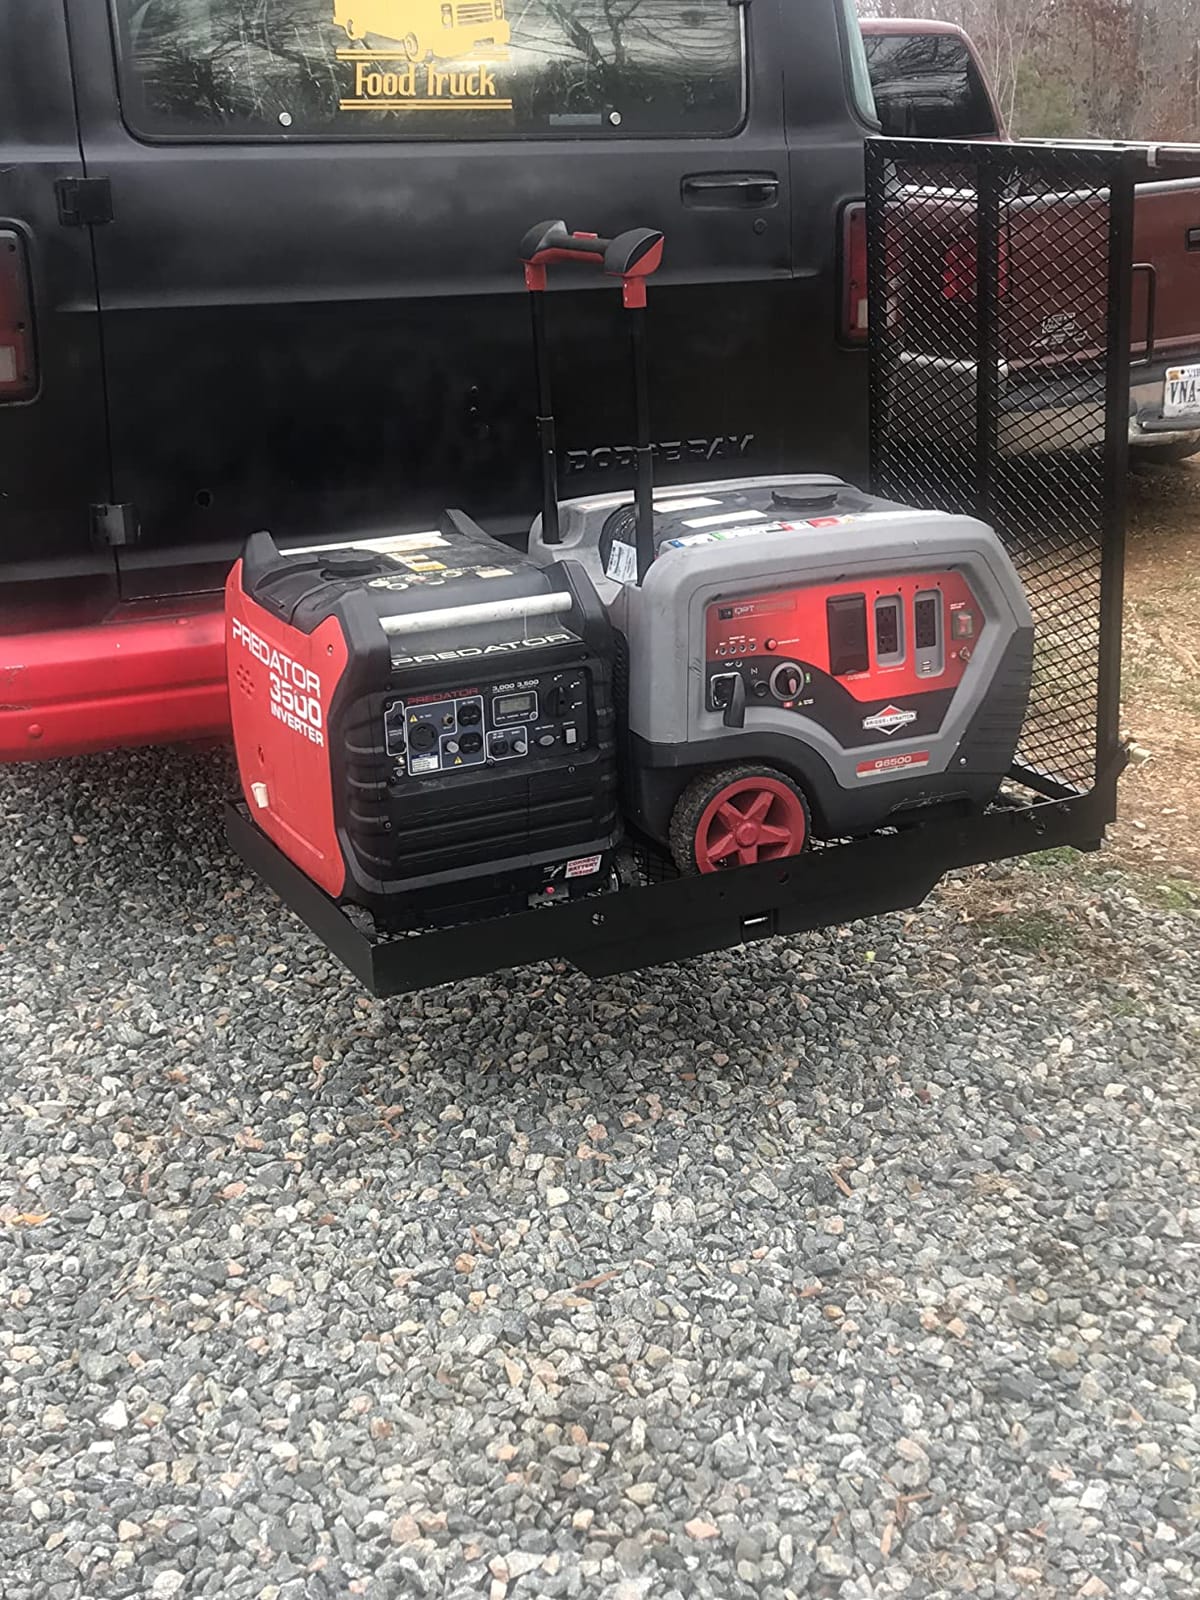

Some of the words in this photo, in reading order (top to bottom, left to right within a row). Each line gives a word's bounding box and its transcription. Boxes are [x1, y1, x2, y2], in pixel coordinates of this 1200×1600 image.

[355, 62, 416, 96] Food
[426, 63, 496, 96] Truck
[232, 617, 321, 698] PREDATOR
[391, 633, 571, 667] PREDATOR
[269, 671, 323, 729] 3500
[406, 687, 480, 705] PREDATOR
[269, 700, 324, 748] INVERTER
